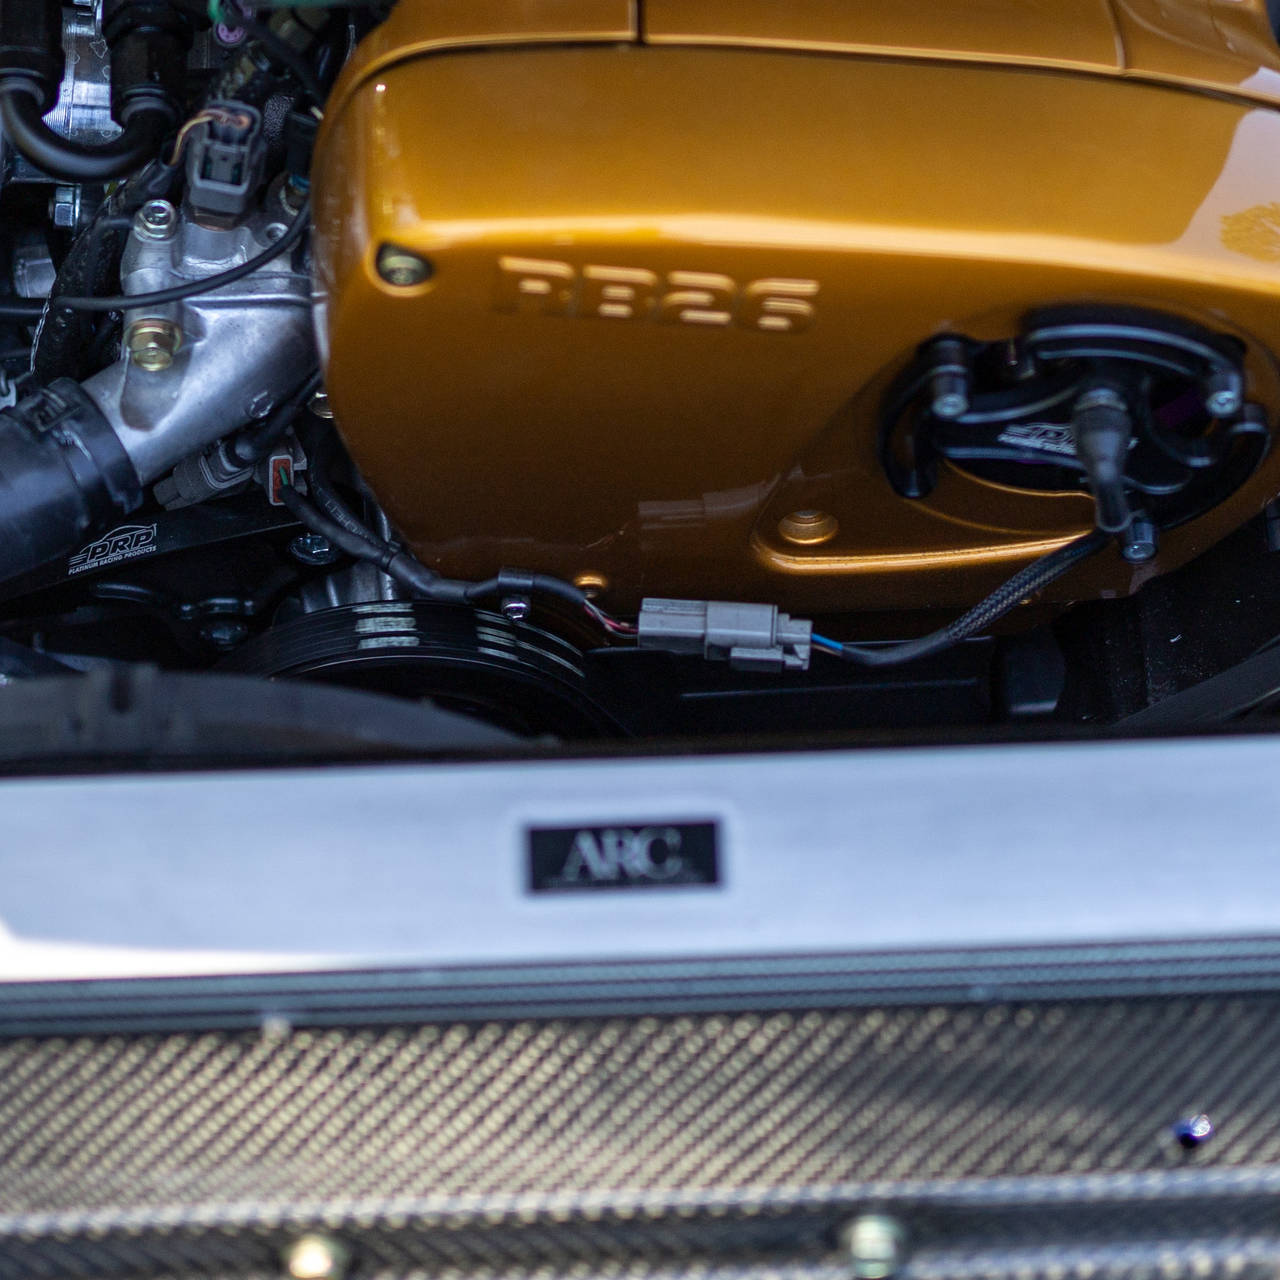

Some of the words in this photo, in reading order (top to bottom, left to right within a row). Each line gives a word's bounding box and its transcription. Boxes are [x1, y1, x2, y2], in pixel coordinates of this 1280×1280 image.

[68, 562, 99, 576] PLATINUM
[100, 554, 122, 567] RACING
[124, 545, 157, 560] PRODUCTS
[87, 529, 154, 564] PRP
[562, 825, 683, 881] ARC
